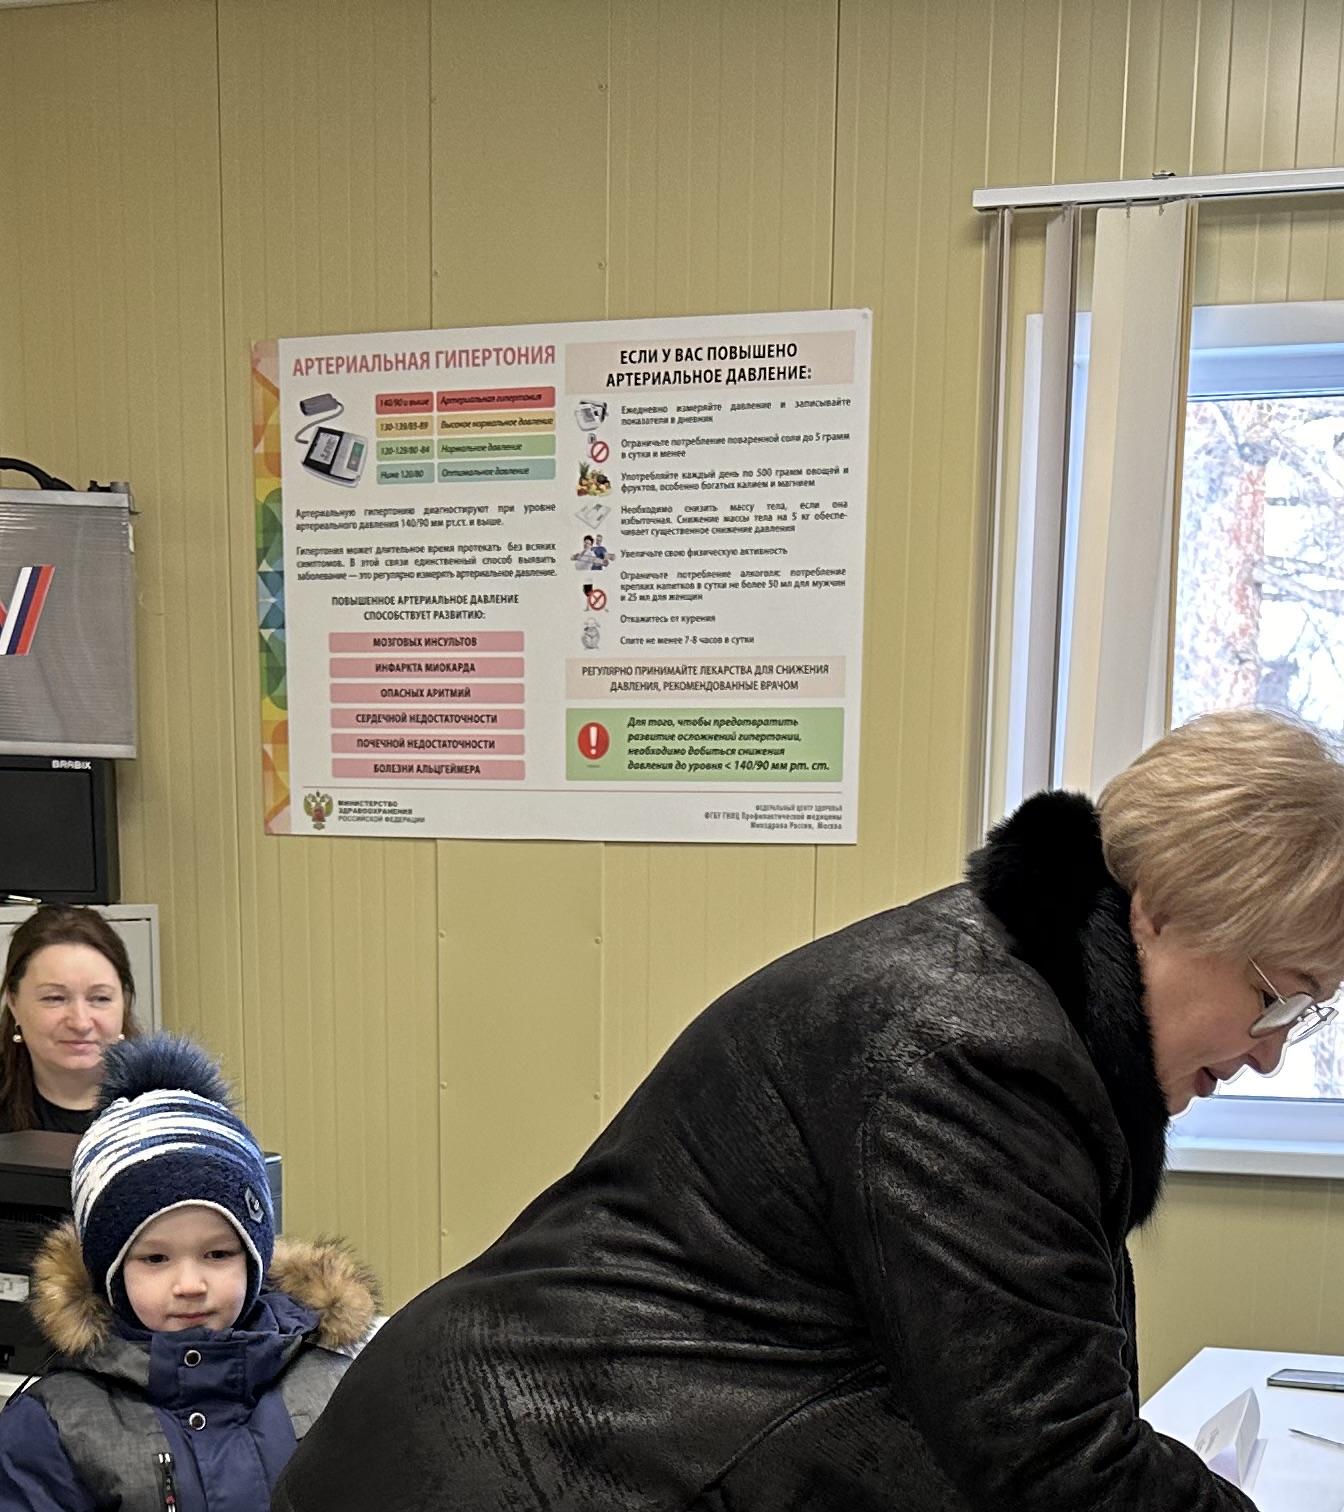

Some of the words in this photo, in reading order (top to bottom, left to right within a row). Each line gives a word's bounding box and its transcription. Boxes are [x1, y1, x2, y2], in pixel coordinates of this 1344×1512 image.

[620, 348, 658, 365] ЕСЛИ
[661, 348, 671, 363] У
[675, 346, 703, 362] ВАС
[707, 342, 797, 361] ПОВЫШЕНО
[291, 350, 430, 377] АРТЕРИАЛЬНАЯ
[435, 344, 555, 369] ГИПЕРТОНИЯ
[605, 368, 722, 388] АРТЕРИАЛЬНОЕ
[725, 364, 811, 385] ДАВЛЕНИЕ:
[815, 431, 820, 441] 5
[331, 595, 395, 606] ПОВЫШЕННОЕ
[397, 594, 468, 605] АРТЕРИАЛЬНОЕ
[469, 593, 519, 606] ДАВЛЕНИЕ
[363, 609, 431, 621] СПОСОБСТВУЕТ
[433, 609, 485, 620] РАЗВИТИЮ:
[372, 636, 422, 647] МОЗГОВЫХ
[424, 636, 477, 647] ИНСУЛЬТОВ
[375, 662, 423, 672] ИНФАРКТА
[424, 662, 475, 674] МИОКАРДА
[581, 665, 633, 676] РЕГУЛЯРНО
[634, 664, 698, 676] ПРИНИМАЙТЕ
[699, 664, 753, 675] ЛЕКАРСТВА
[753, 664, 774, 676] ДЛЯ
[775, 663, 829, 675] СНИЖЕНИЯ
[380, 687, 424, 698] ОПАСНЫХ
[425, 686, 471, 697] АРИТМИЙ
[609, 681, 661, 692] ДАВЛЕНИЯ,
[662, 680, 759, 692] РЕКОМЕНДОВАННЫЕ
[759, 679, 798, 690] ВРАЧОМ
[355, 712, 407, 724] СЕРДЕЧНОЙ
[408, 713, 497, 725] НЕДОСТАТОЧНОСТИ
[356, 737, 405, 748] ПОЧЕЧНОЙ
[406, 738, 495, 750] НЕДОСТАТОЧНОСТИ
[52, 759, 91, 769] BRABIX
[373, 763, 414, 773] БОЛЕЗНИ
[415, 762, 481, 776] АЛЬЦГЕЙМЕРА
